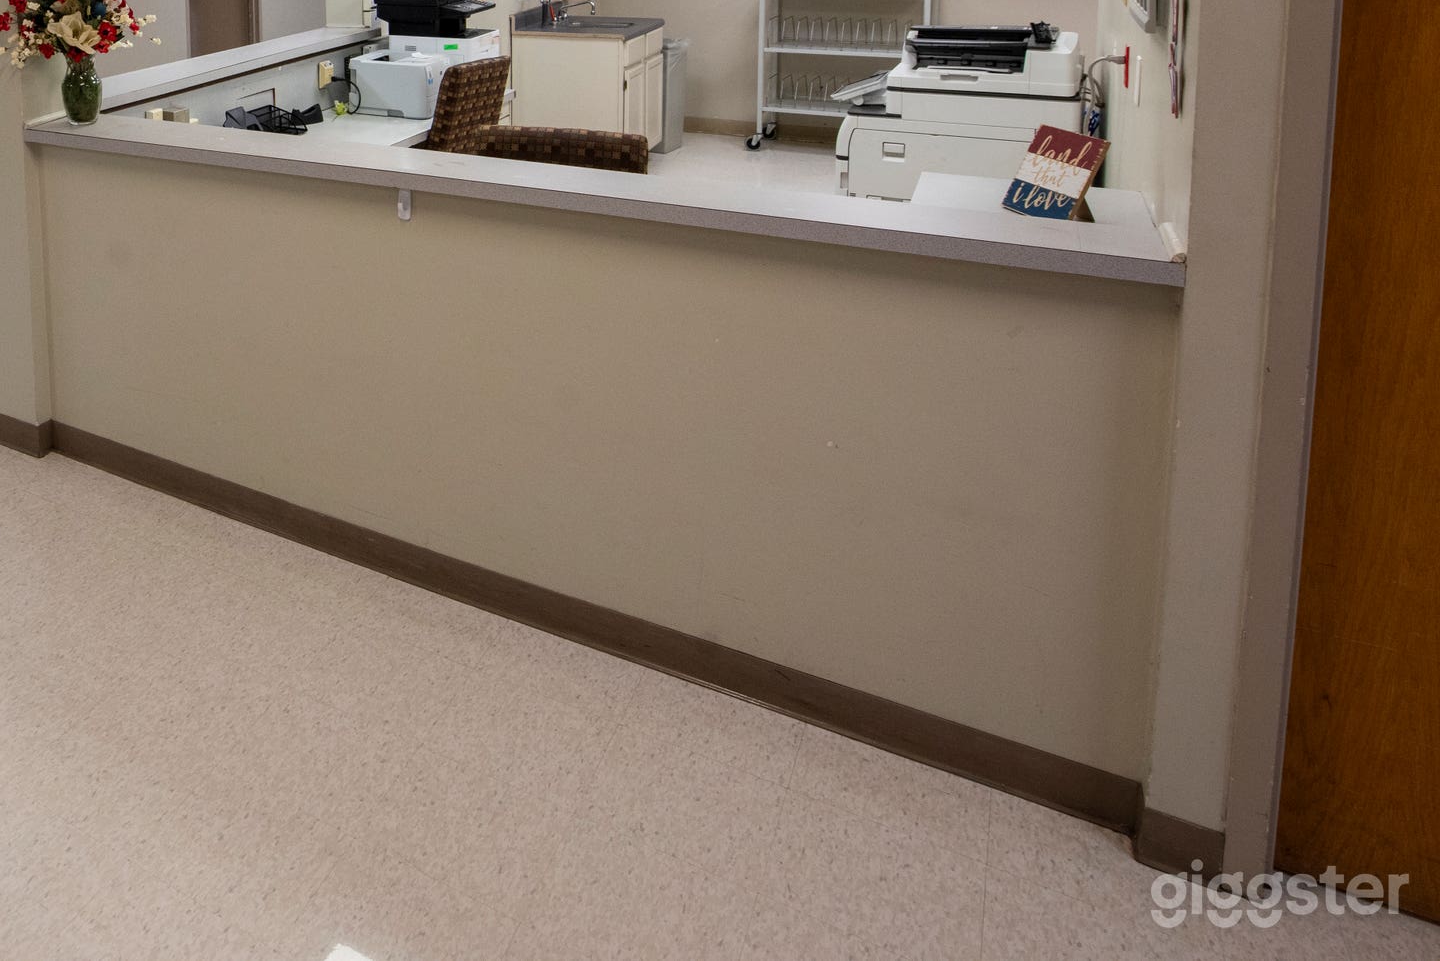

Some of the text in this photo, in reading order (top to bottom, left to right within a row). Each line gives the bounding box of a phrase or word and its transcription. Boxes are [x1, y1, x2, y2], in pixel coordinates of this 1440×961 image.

[1031, 135, 1093, 175] land
[1033, 168, 1067, 187] that
[1012, 182, 1072, 211] i love
